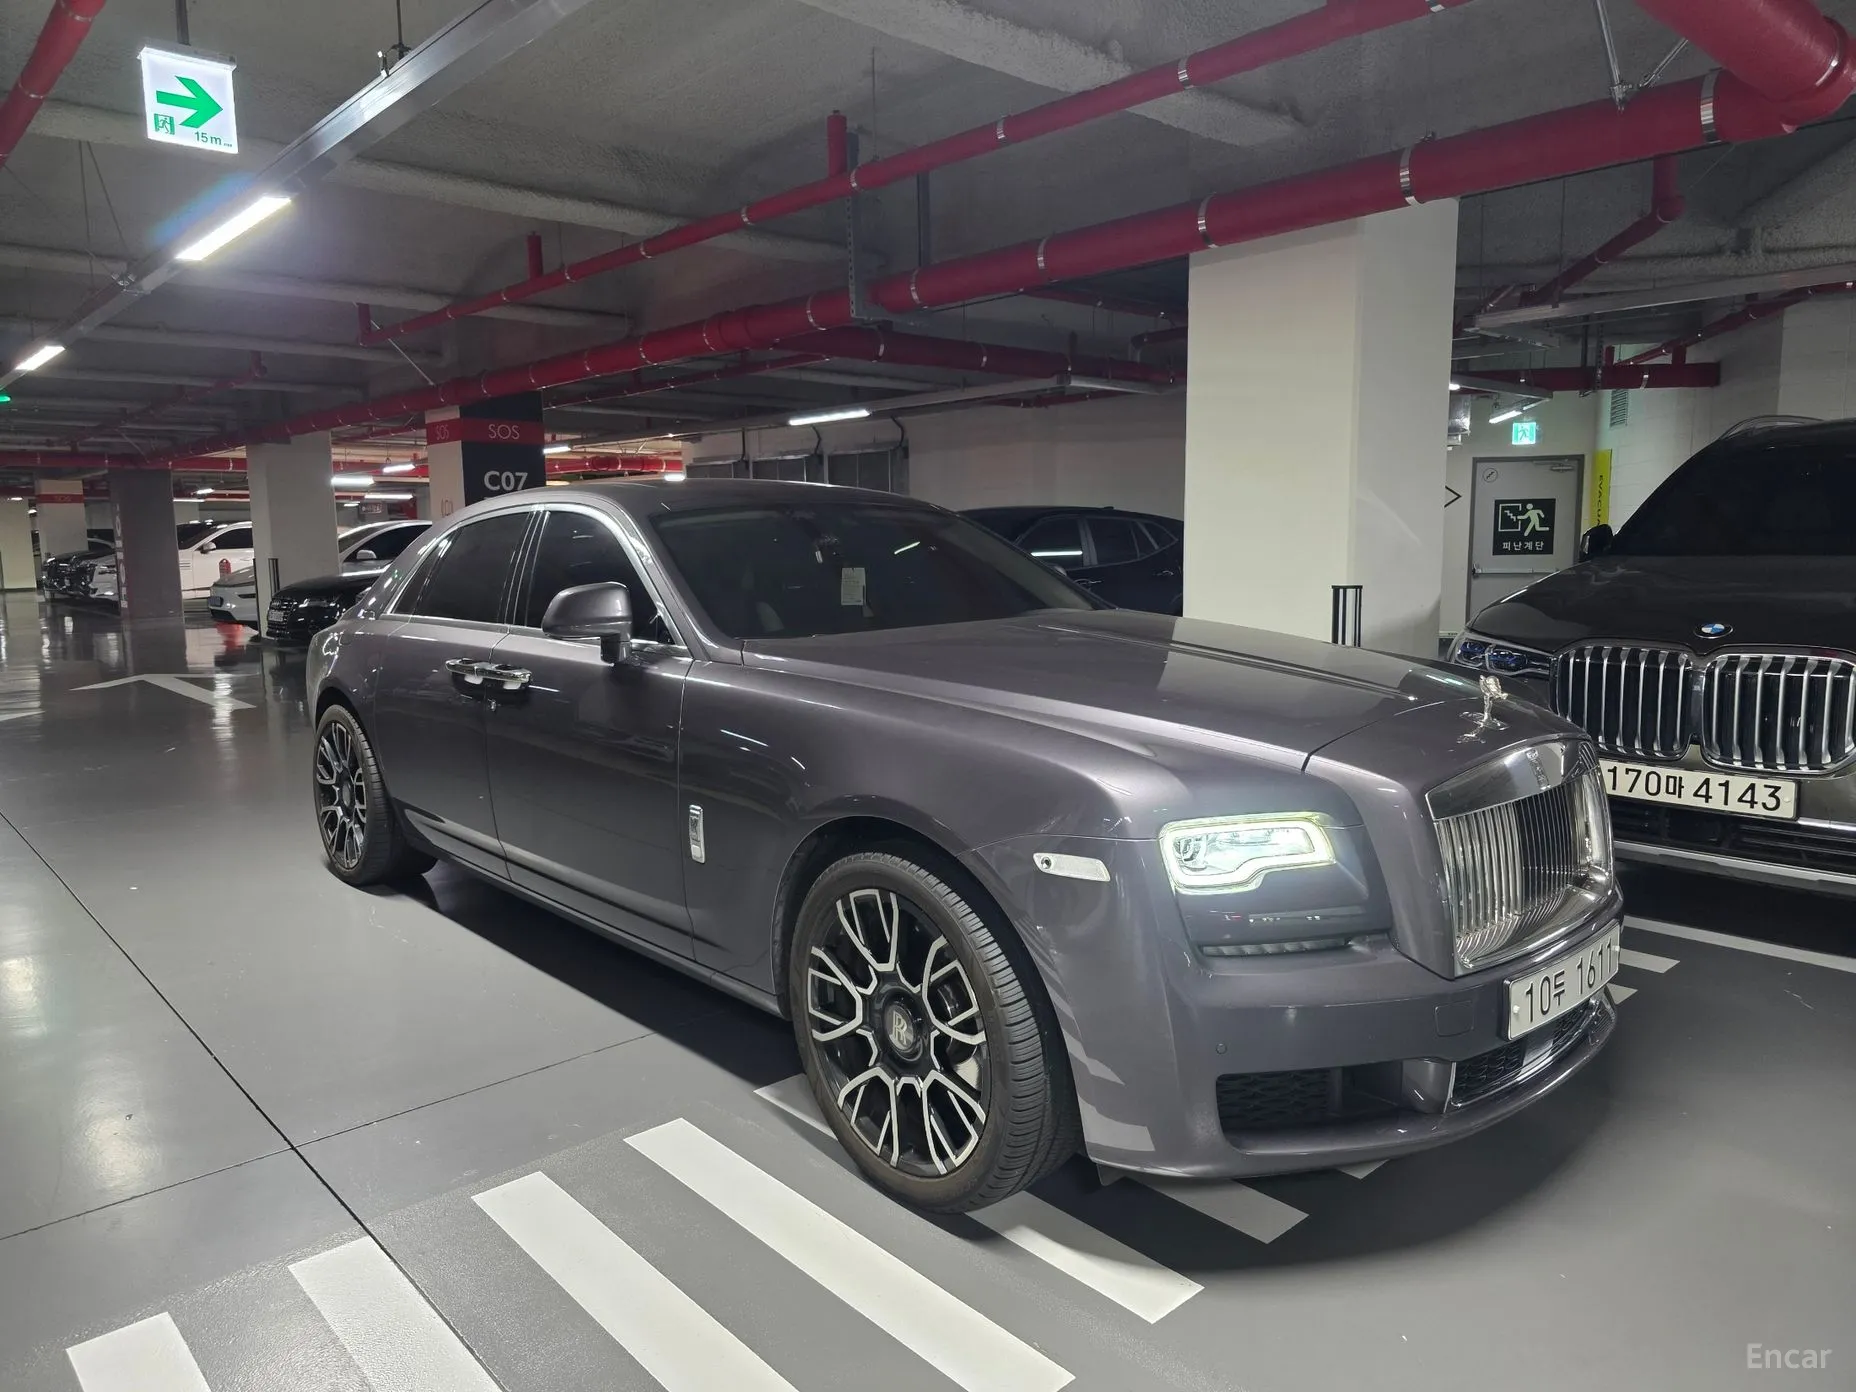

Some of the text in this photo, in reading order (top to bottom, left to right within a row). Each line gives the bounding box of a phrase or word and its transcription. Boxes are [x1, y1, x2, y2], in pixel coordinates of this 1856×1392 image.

[488, 423, 520, 440] SOS
[483, 470, 528, 491] C07
[1692, 777, 1782, 812] 4143
[1576, 937, 1612, 995] 1611
